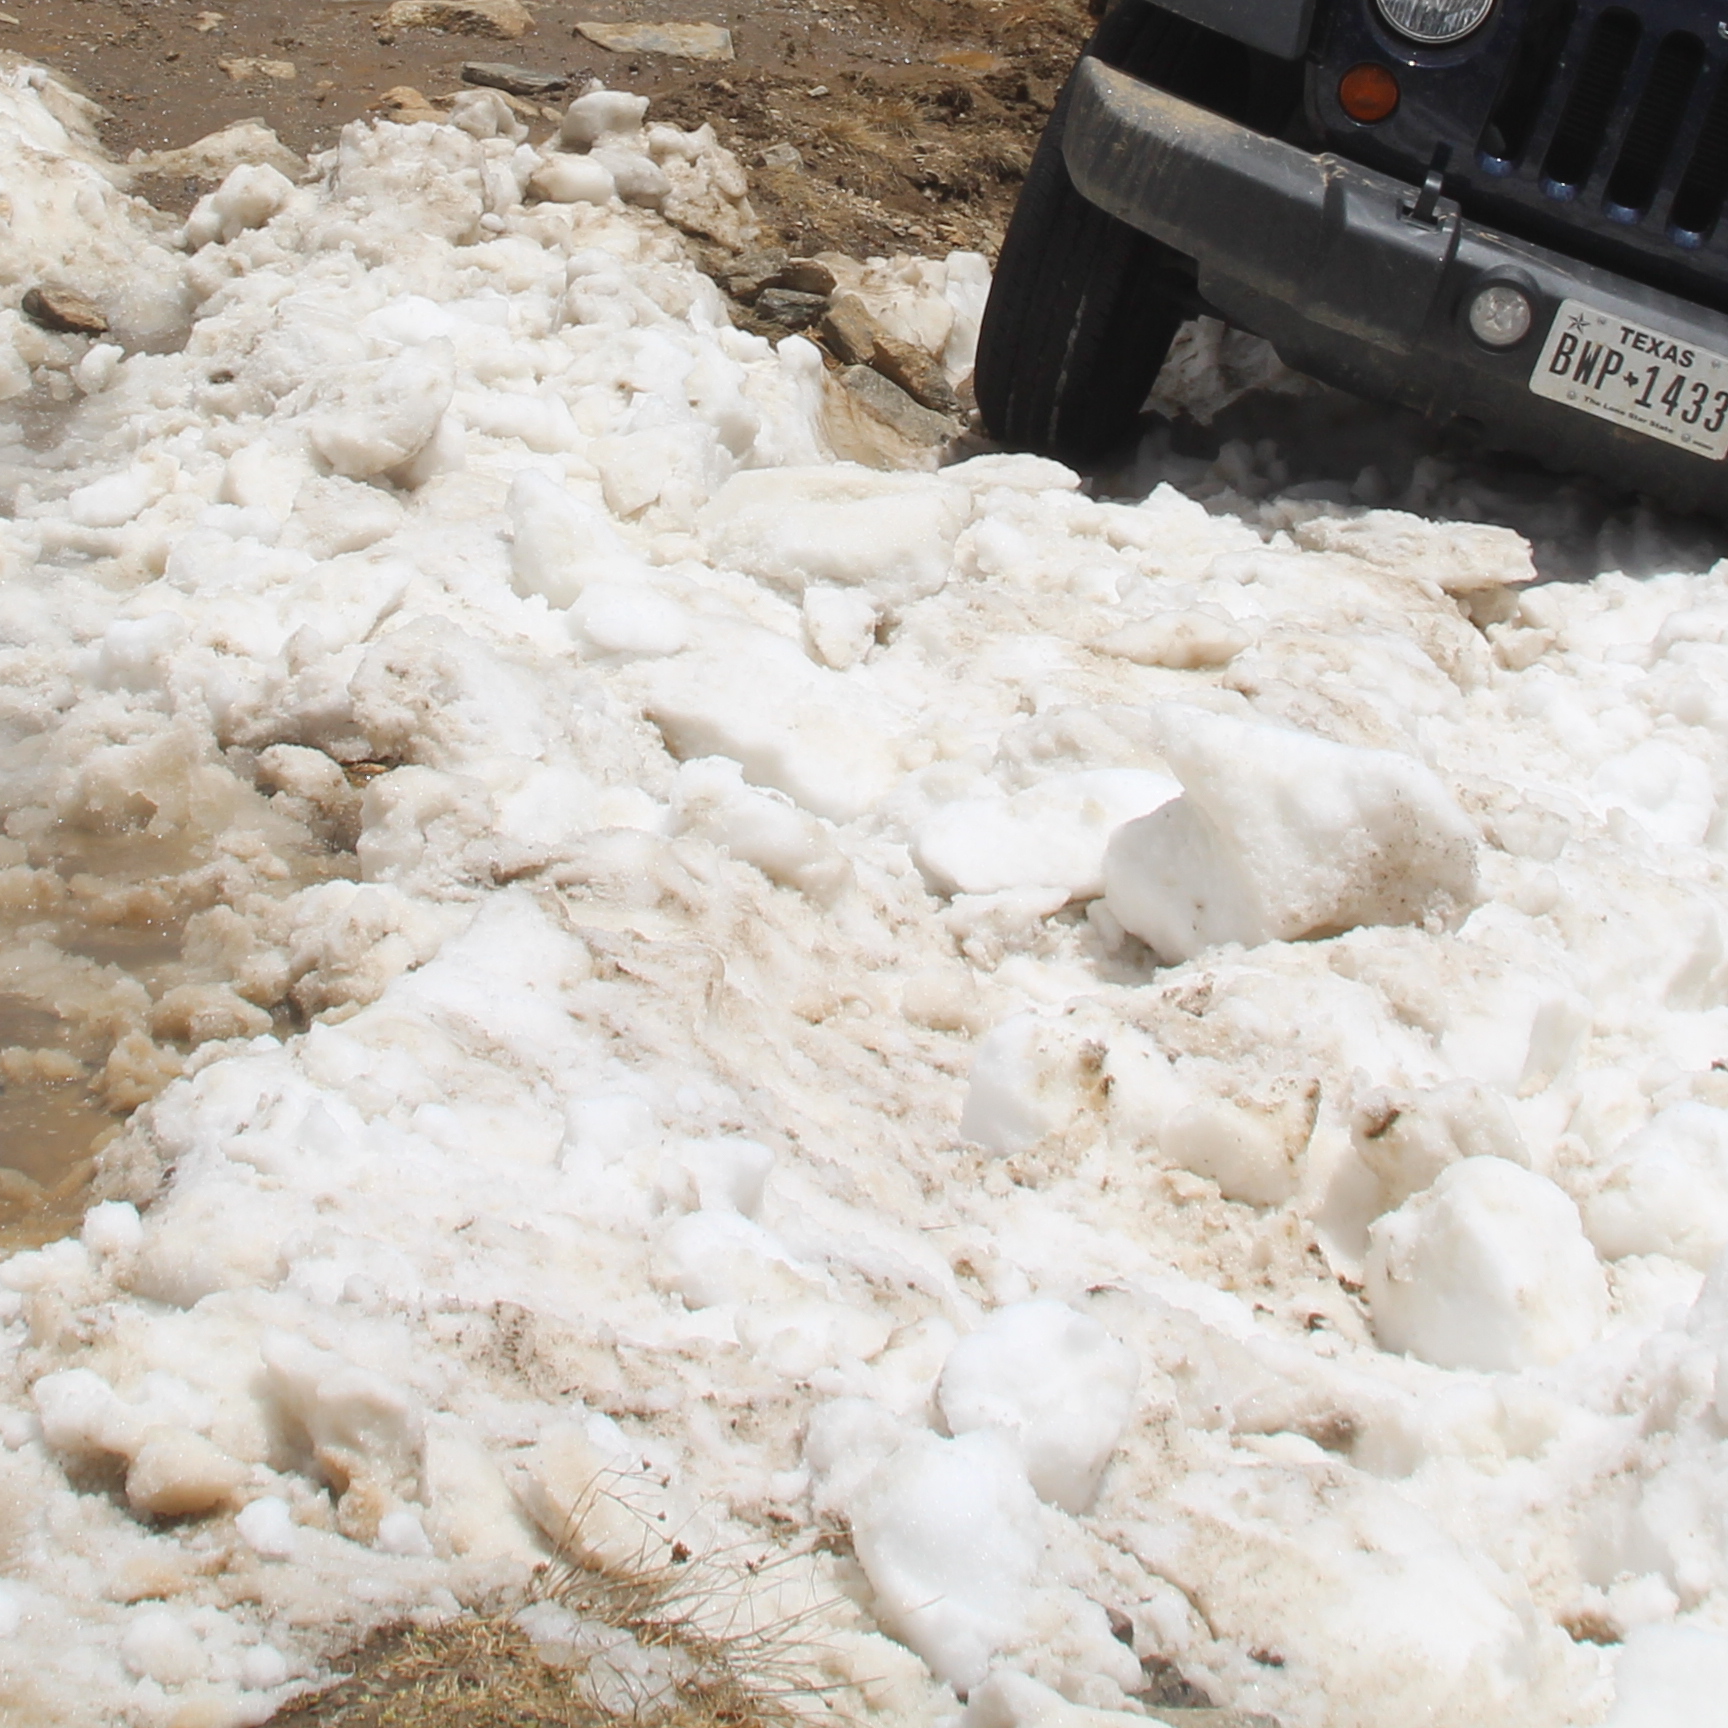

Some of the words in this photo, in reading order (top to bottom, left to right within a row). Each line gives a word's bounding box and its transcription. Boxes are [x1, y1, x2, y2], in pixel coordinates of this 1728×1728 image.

[1549, 332, 1625, 390] BWP
[1620, 326, 1696, 368] TEXAS
[1584, 395, 1601, 406] The
[1603, 403, 1626, 416] Lone
[1628, 412, 1648, 424] Star
[1649, 420, 1674, 434] State
